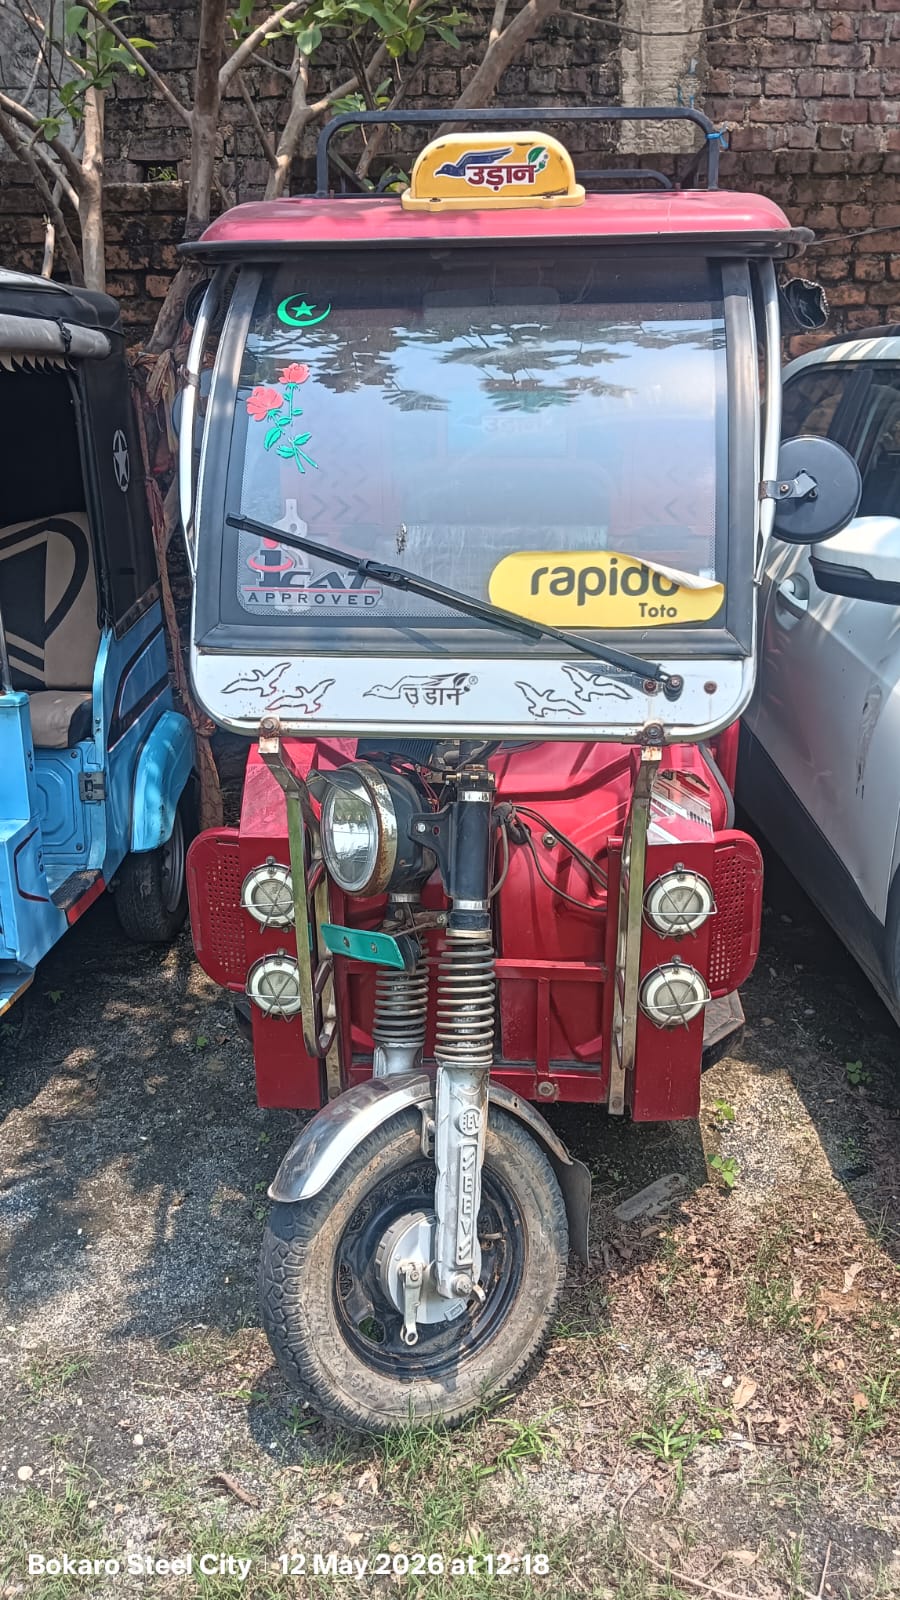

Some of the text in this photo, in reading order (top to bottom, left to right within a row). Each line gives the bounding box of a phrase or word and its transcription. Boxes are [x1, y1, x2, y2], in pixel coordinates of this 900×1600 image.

[466, 164, 537, 191] उड़ान
[530, 557, 681, 606] rapido
[247, 591, 376, 606] APPROVED
[638, 602, 678, 618] Toto
